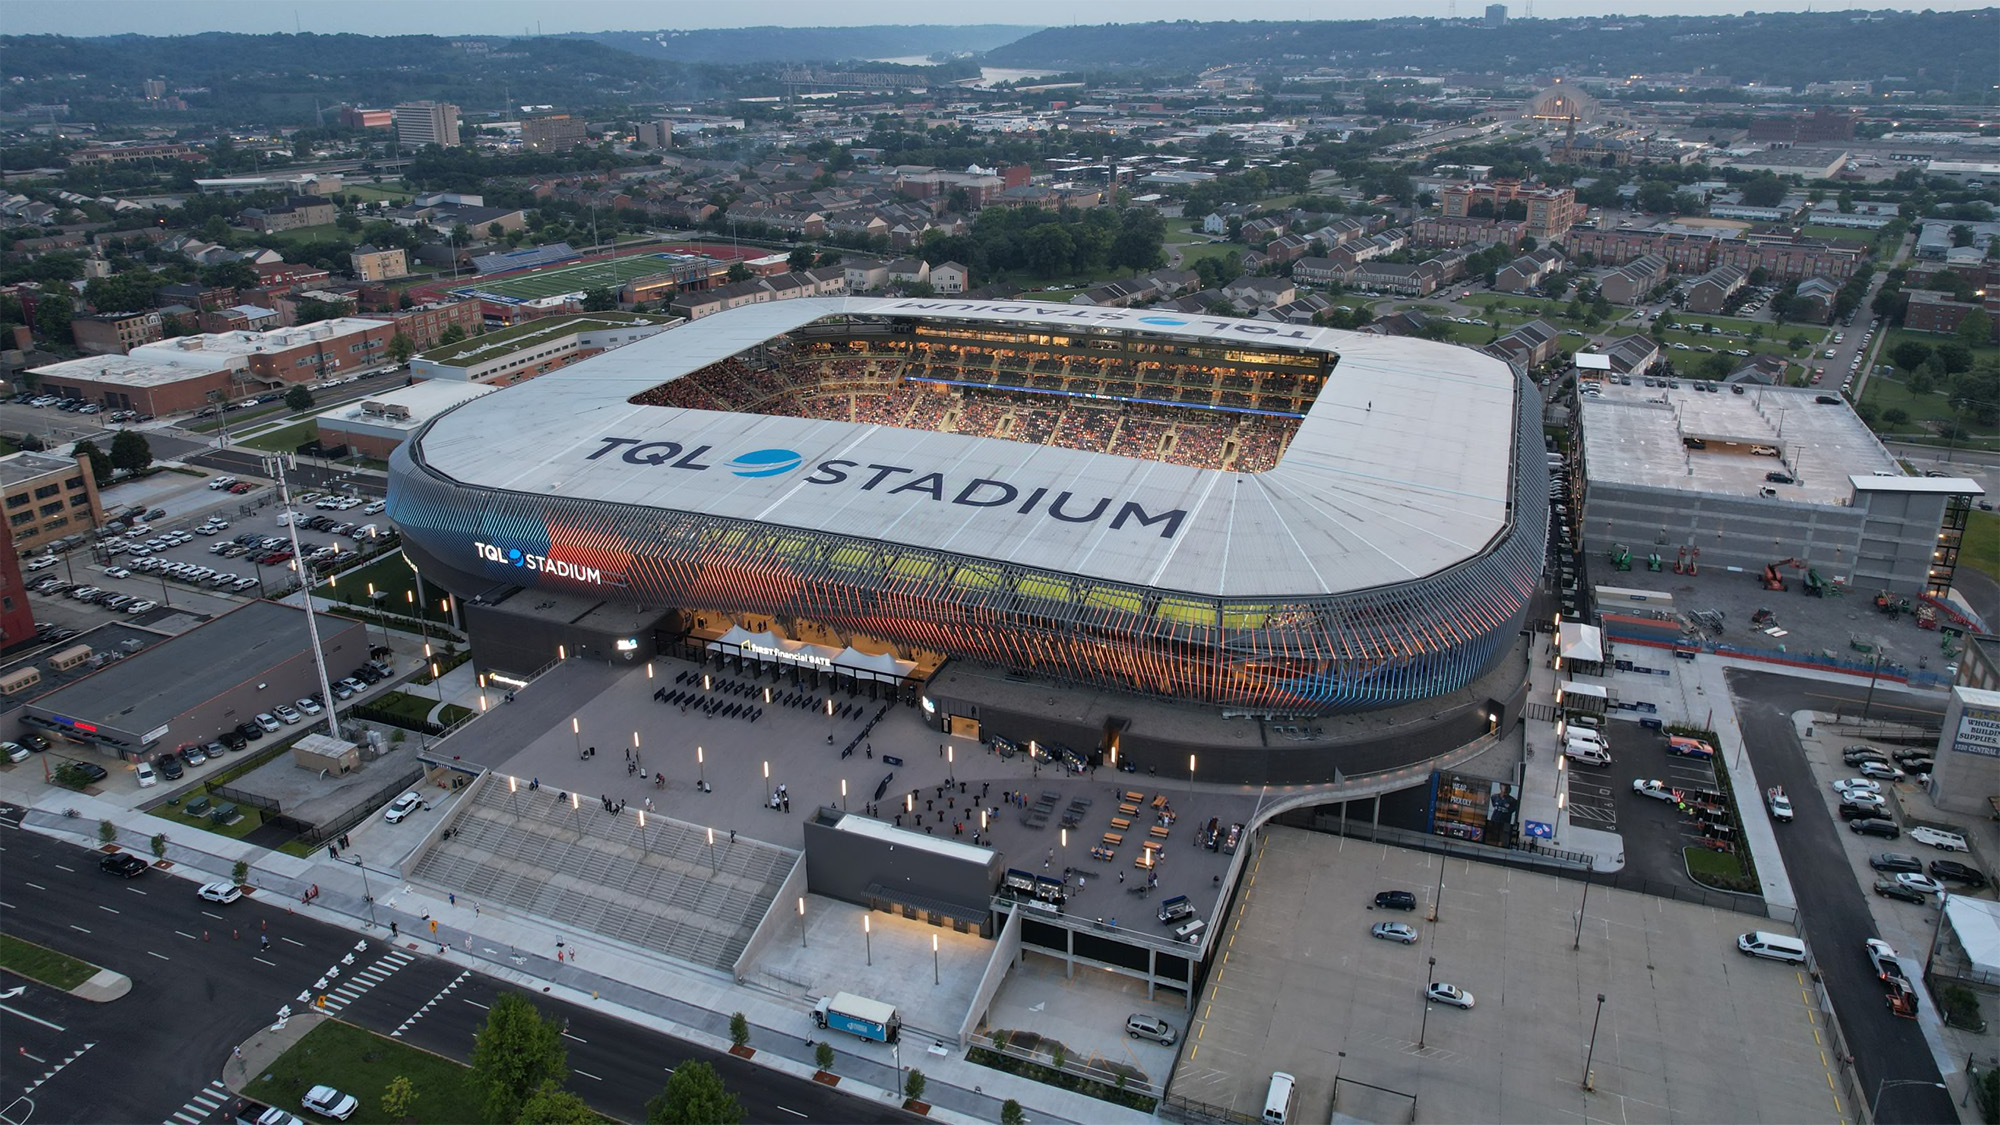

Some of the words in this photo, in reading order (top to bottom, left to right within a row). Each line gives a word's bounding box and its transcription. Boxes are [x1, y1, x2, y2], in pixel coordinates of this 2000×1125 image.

[894, 302, 1131, 321] STADIUM
[1202, 320, 1312, 340] TQL
[585, 437, 713, 471] TQL
[803, 459, 1188, 539] STADIUM
[475, 542, 508, 564] TQL
[525, 554, 601, 585] STADIUM
[774, 647, 808, 662] financial
[808, 655, 831, 667] GATE
[1968, 745, 1997, 755] CENTRAL
